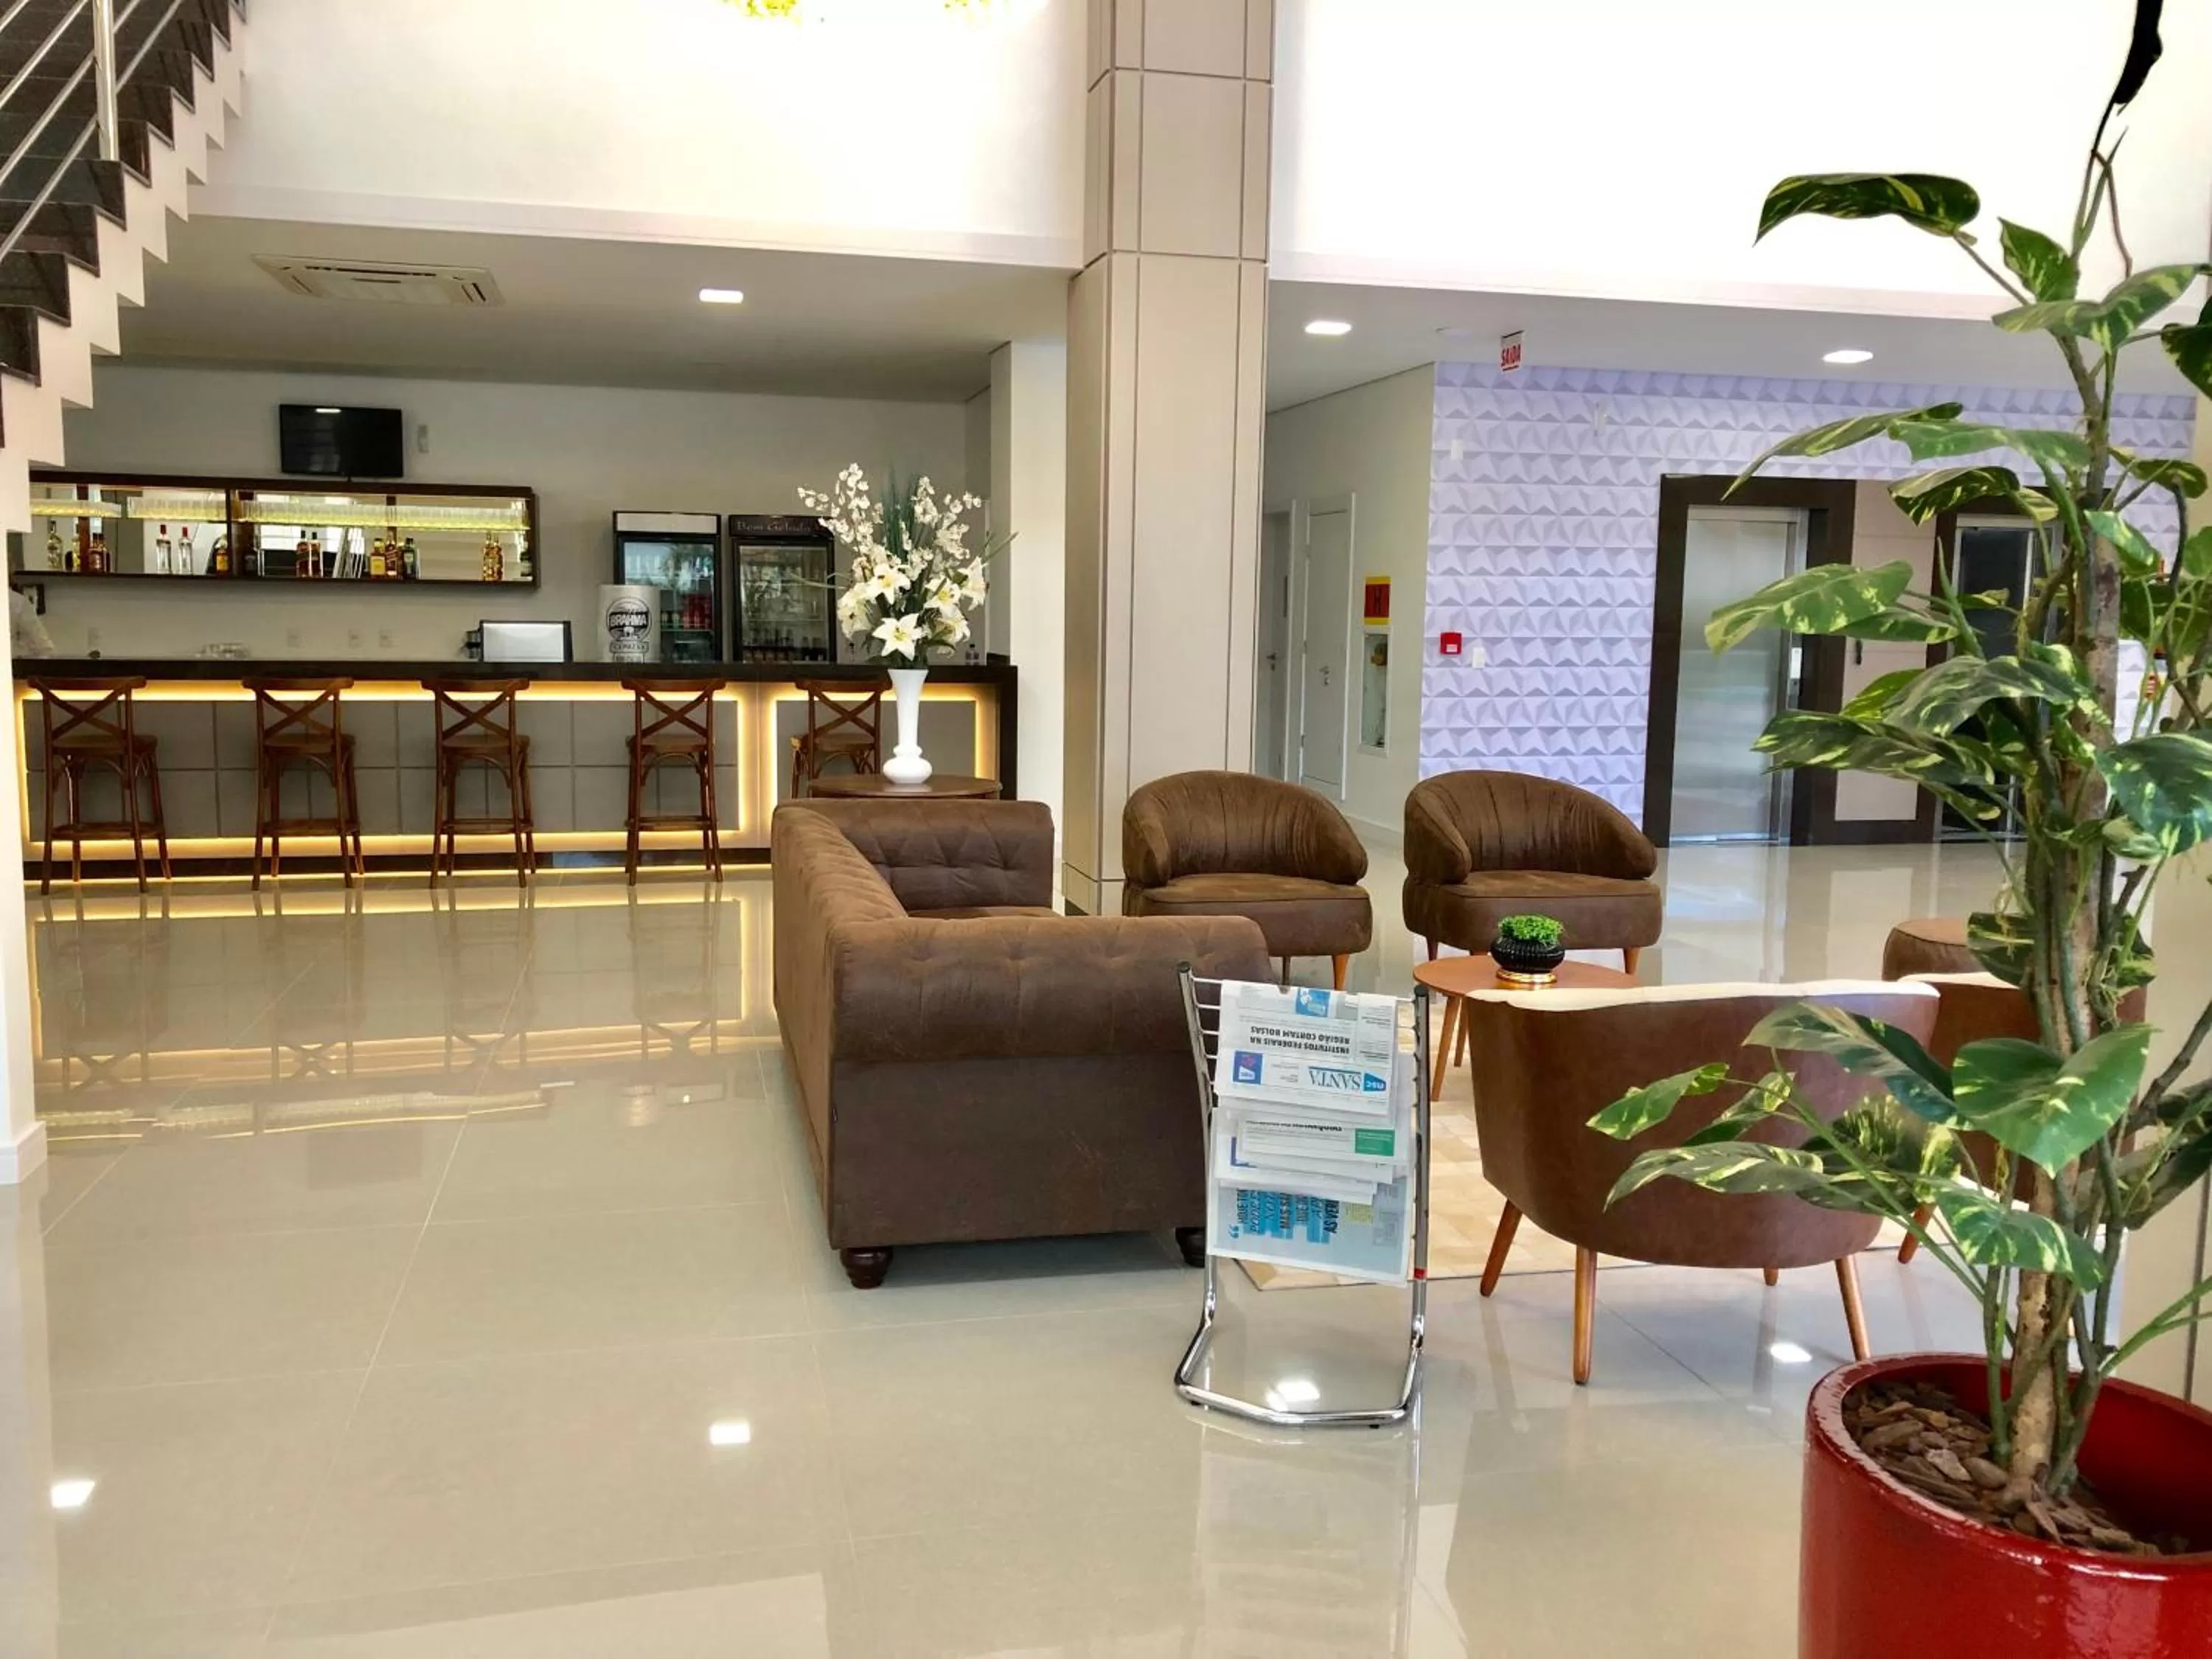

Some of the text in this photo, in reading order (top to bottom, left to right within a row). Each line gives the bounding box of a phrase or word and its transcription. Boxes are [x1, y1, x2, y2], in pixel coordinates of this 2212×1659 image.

[610, 613, 647, 627] BRAHMA
[1251, 1026, 1350, 1045] REGIÃO CORTAM BOLSAS
[1263, 1038, 1301, 1050] FEDERAIS
[1304, 1043, 1349, 1054] INSTITUTOS
[1309, 1070, 1362, 1091] SANTA
